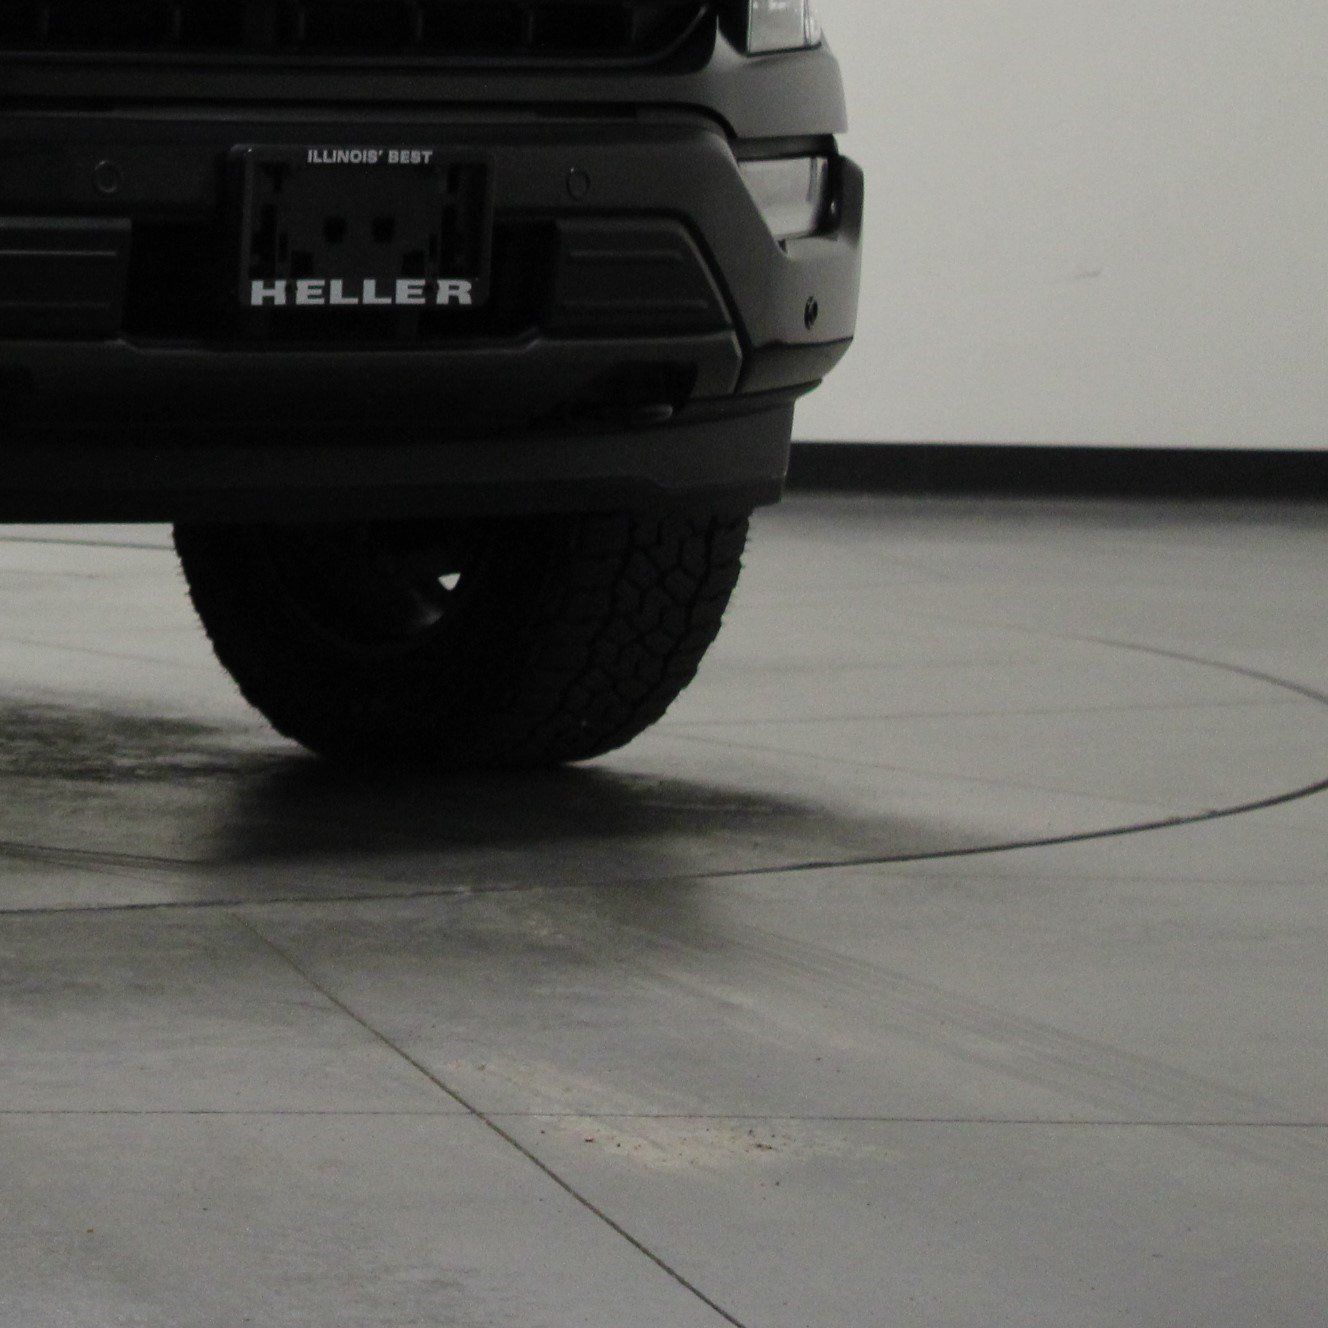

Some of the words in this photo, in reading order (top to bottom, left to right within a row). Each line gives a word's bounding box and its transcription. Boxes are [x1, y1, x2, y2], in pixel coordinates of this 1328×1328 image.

[307, 149, 383, 164] ILLINOIS'
[388, 150, 433, 164] BEST
[250, 278, 473, 306] HELLER
